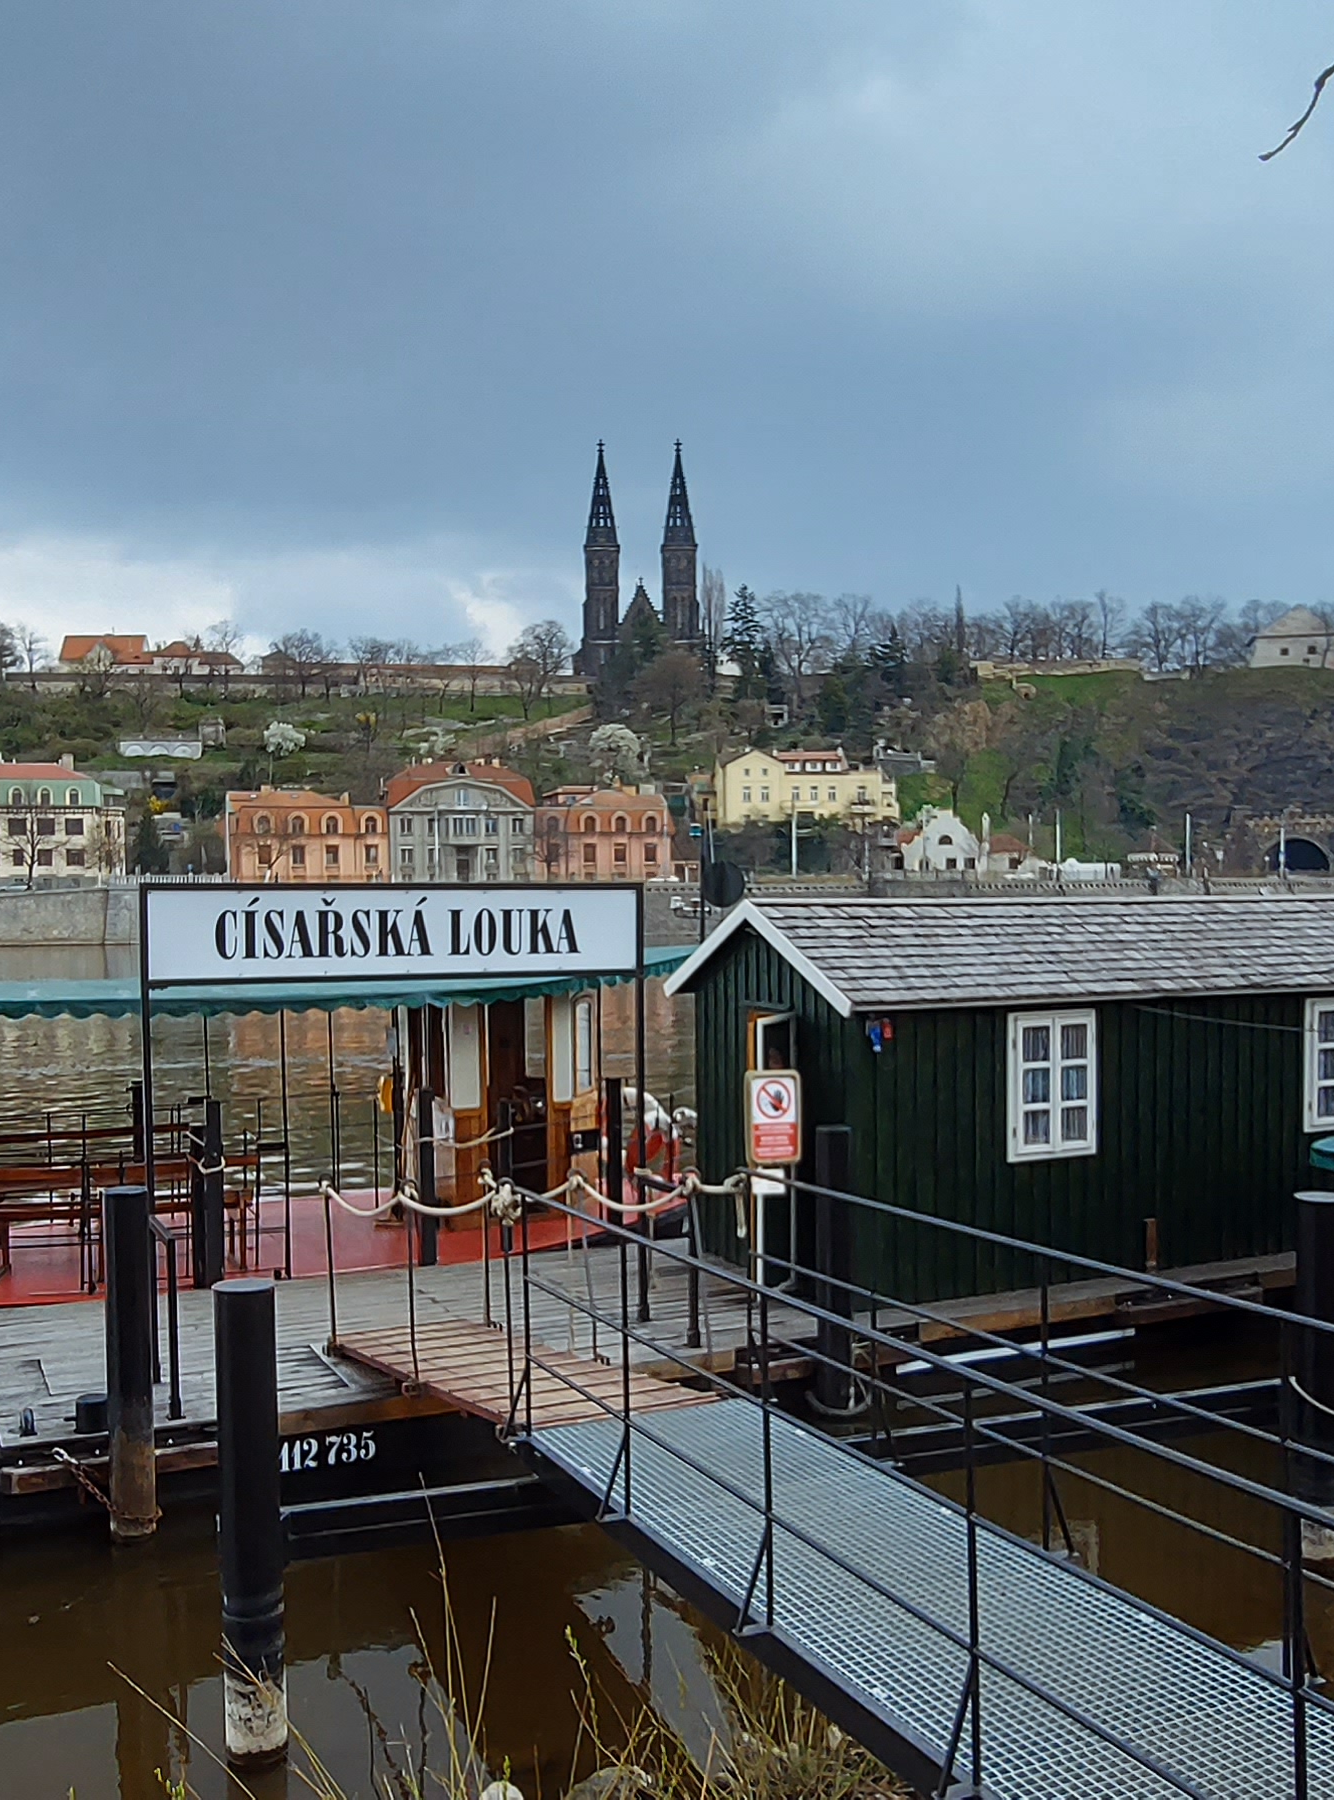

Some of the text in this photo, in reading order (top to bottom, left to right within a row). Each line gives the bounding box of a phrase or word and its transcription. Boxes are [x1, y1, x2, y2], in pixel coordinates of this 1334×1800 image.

[214, 897, 581, 960] CÍSAŘSKÁ LOUKA
[279, 1430, 376, 1473] 112 735
